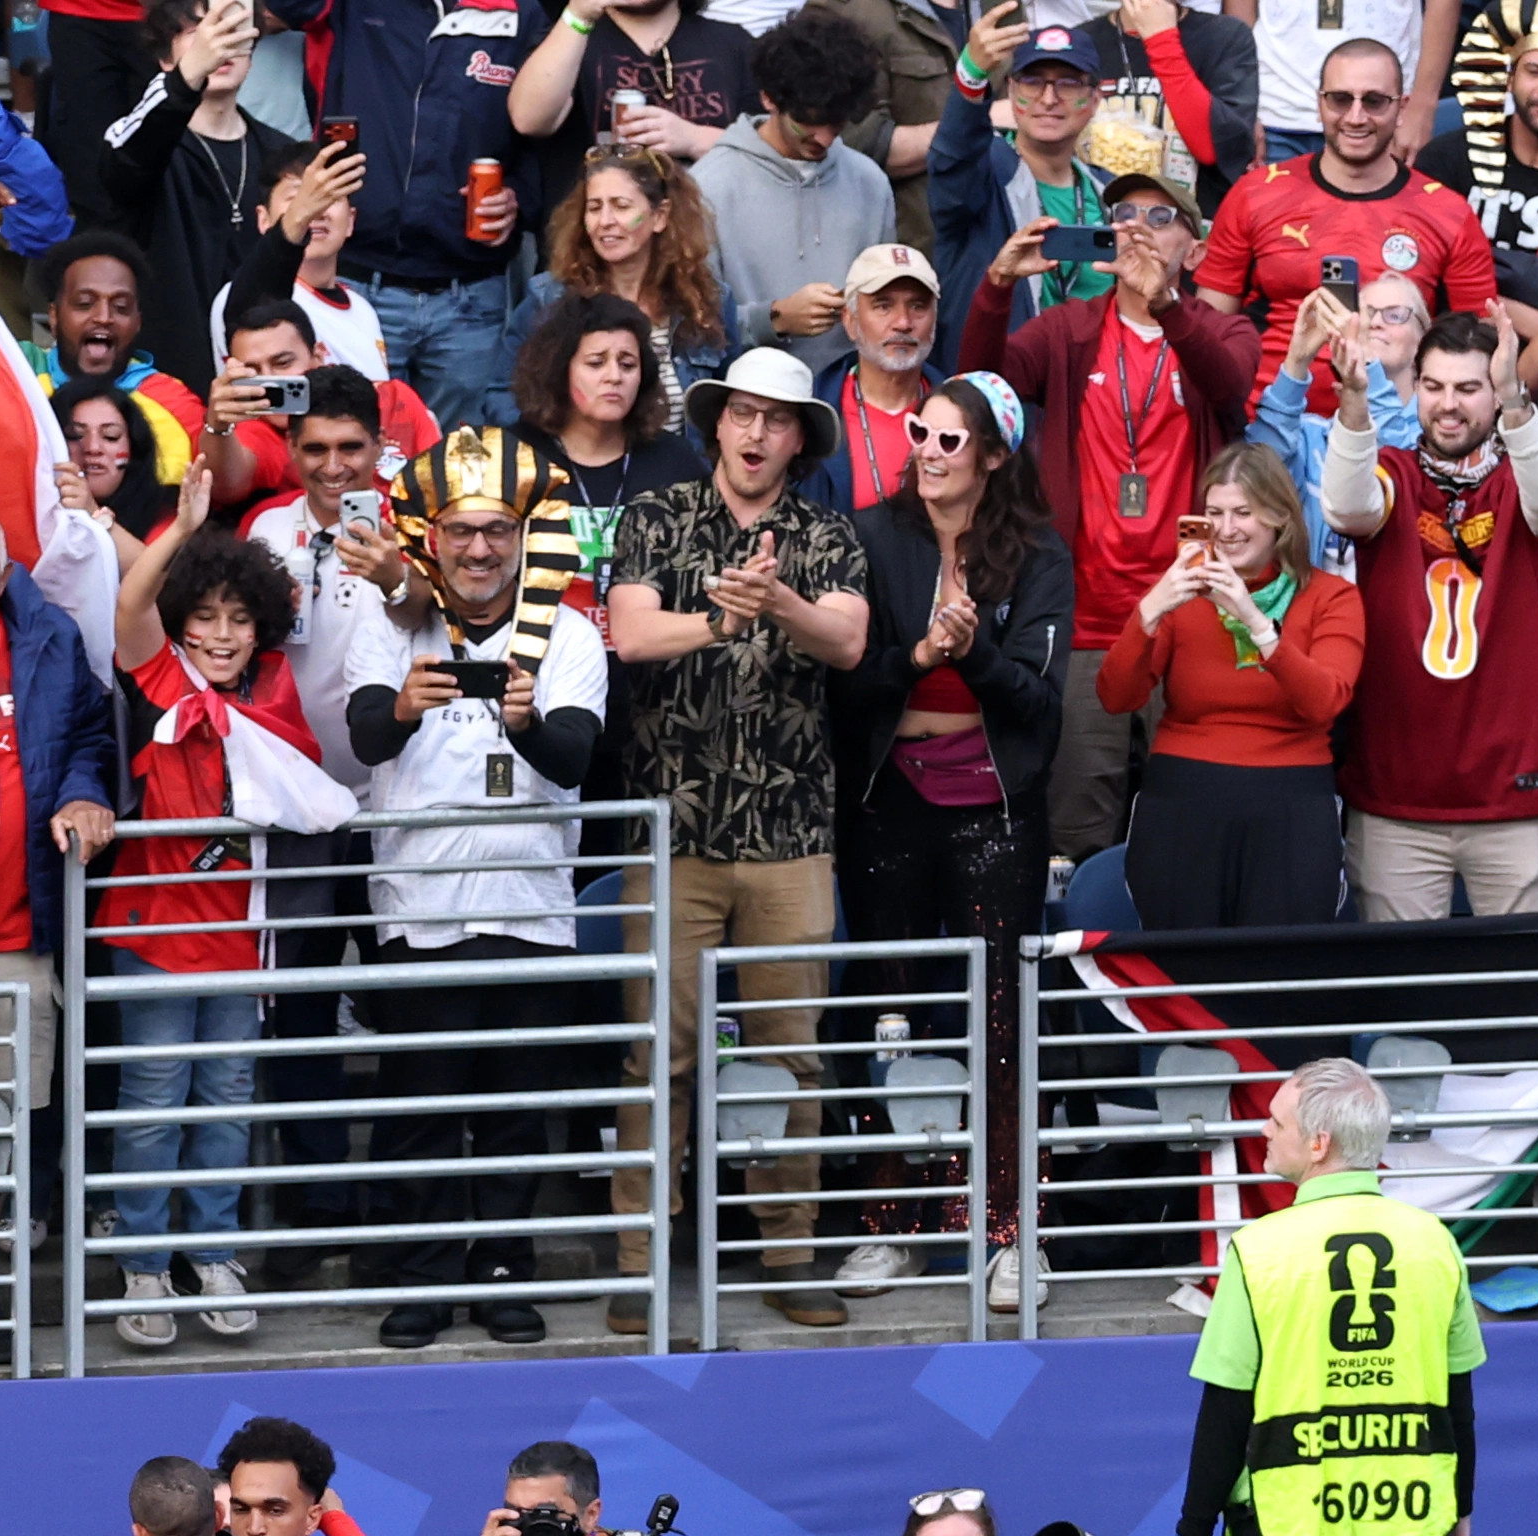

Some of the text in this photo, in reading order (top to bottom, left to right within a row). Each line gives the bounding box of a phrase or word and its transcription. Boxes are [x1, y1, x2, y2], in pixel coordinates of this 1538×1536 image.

[1347, 1327, 1377, 1343] FIFA
[1328, 1356, 1395, 1369] WORLD CUP
[1326, 1370, 1395, 1388] 2026
[1293, 1412, 1431, 1458] SECURIT
